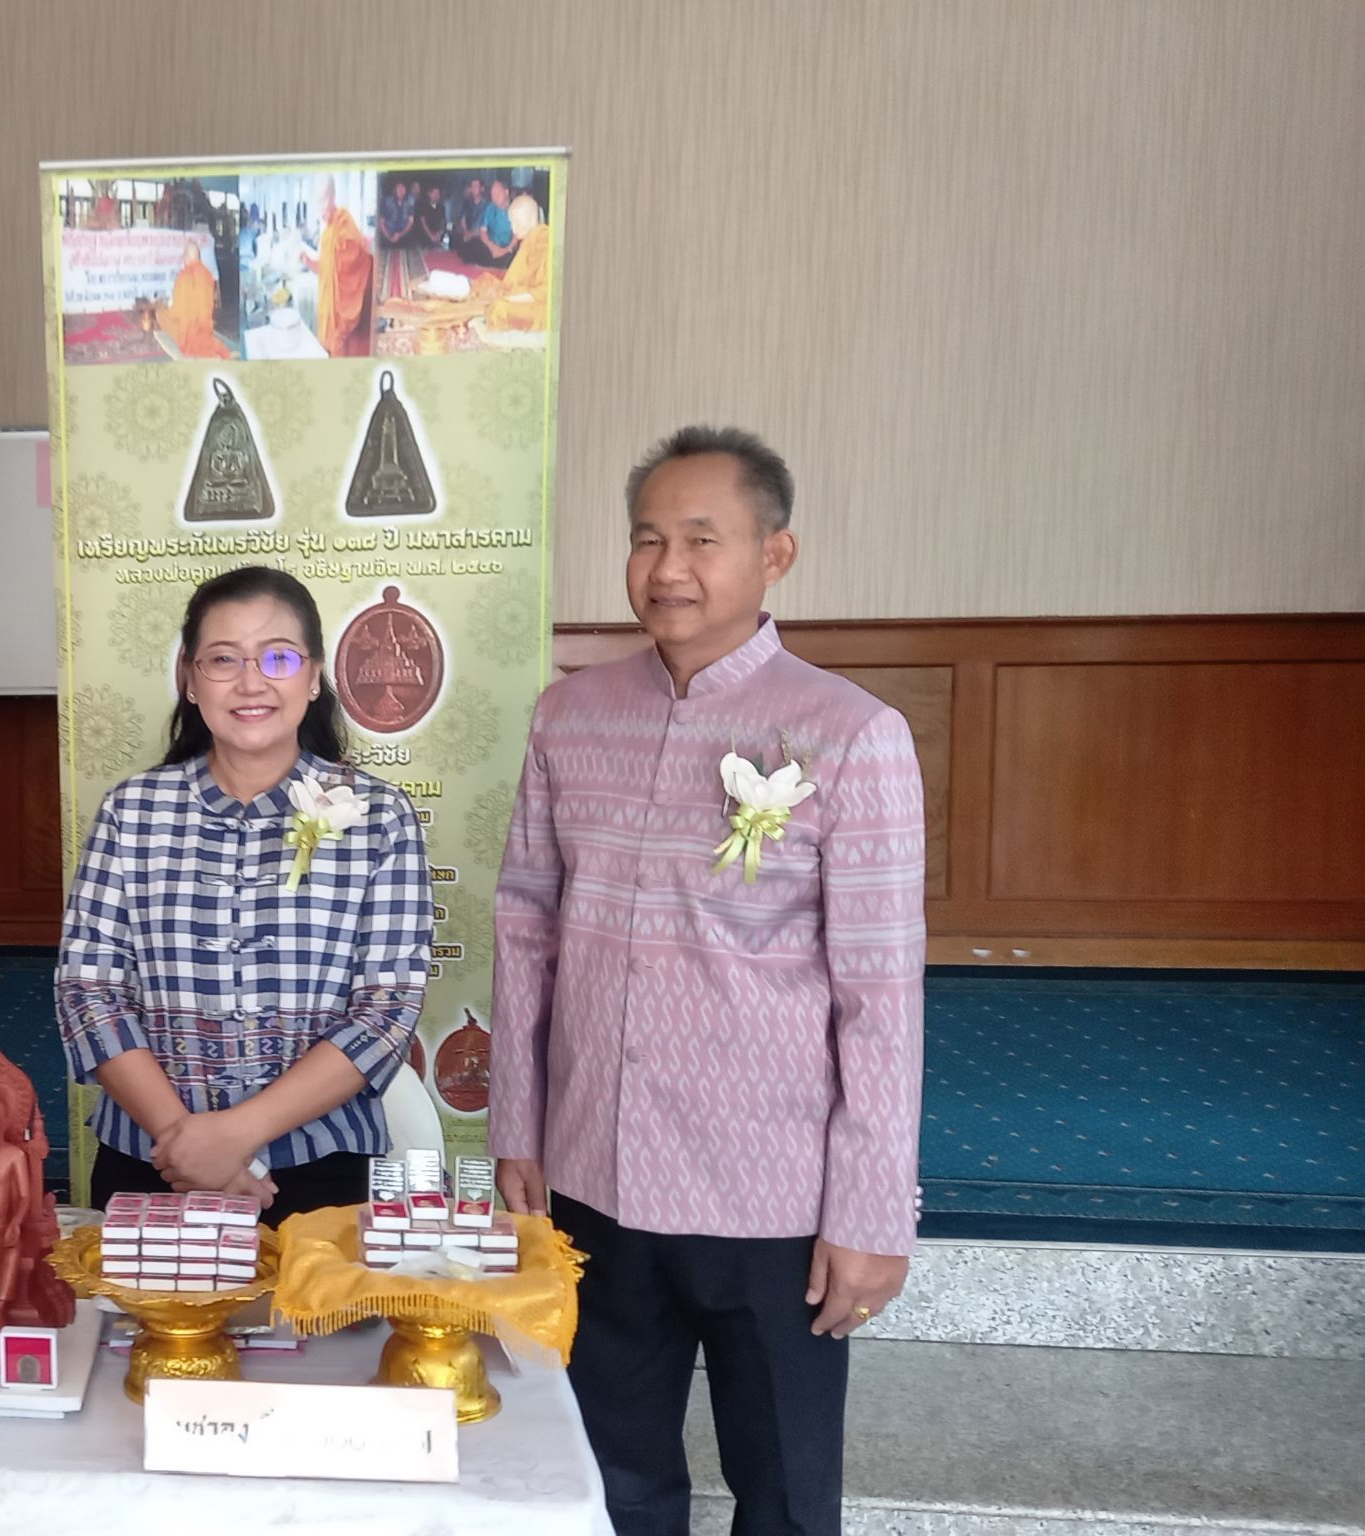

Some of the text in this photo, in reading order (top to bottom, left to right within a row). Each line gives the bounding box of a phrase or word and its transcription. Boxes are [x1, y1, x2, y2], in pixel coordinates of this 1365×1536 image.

[296, 527, 327, 558] รุ่น
[383, 526, 401, 549] ปี
[406, 527, 533, 550] มหาสารคาม
